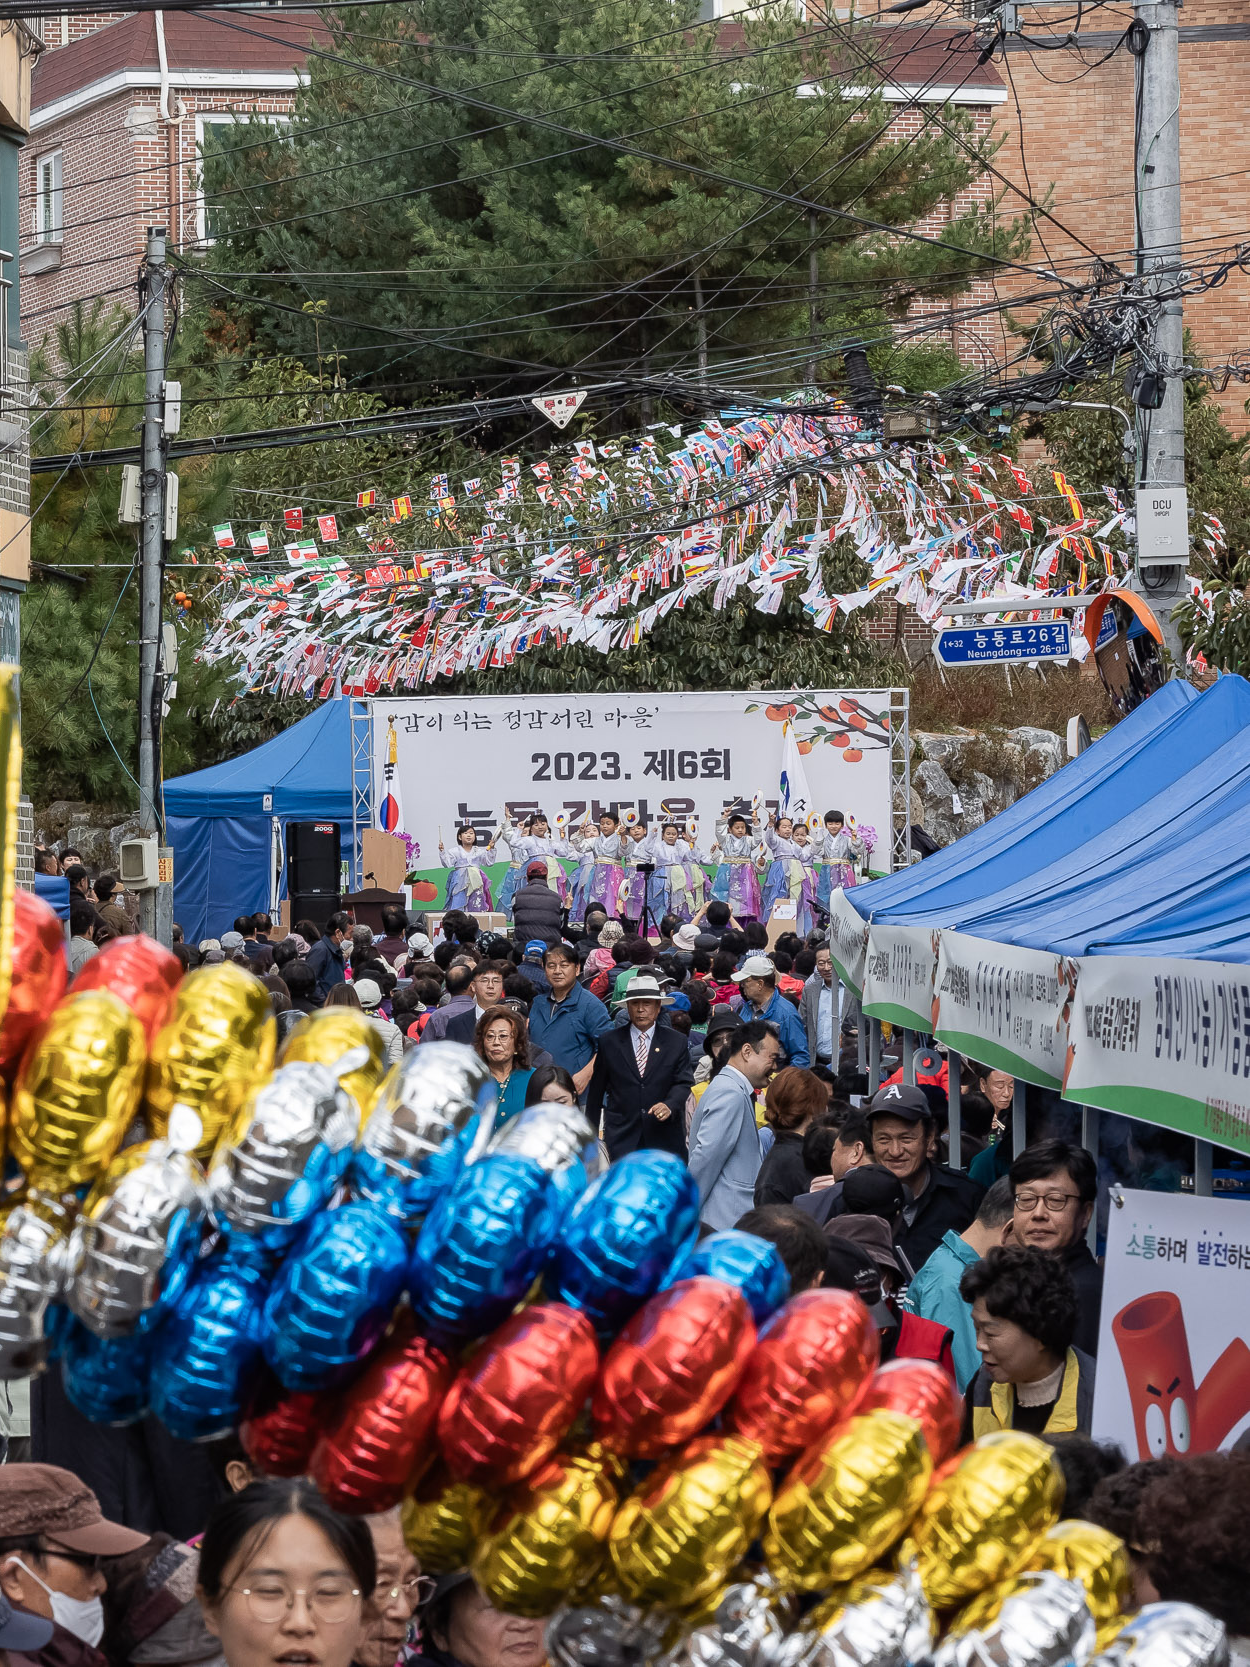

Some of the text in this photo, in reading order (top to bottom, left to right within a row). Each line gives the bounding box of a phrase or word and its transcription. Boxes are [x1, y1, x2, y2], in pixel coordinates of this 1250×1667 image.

[1152, 500, 1172, 510] DCU
[967, 643, 1068, 659] Neungdong-ro 26-gil
[453, 710, 493, 731] 익는
[502, 708, 594, 730] 정감어린
[531, 747, 731, 782] 2023. 제6회
[883, 1084, 903, 1100] A
[1125, 1232, 1187, 1264] 소통하며
